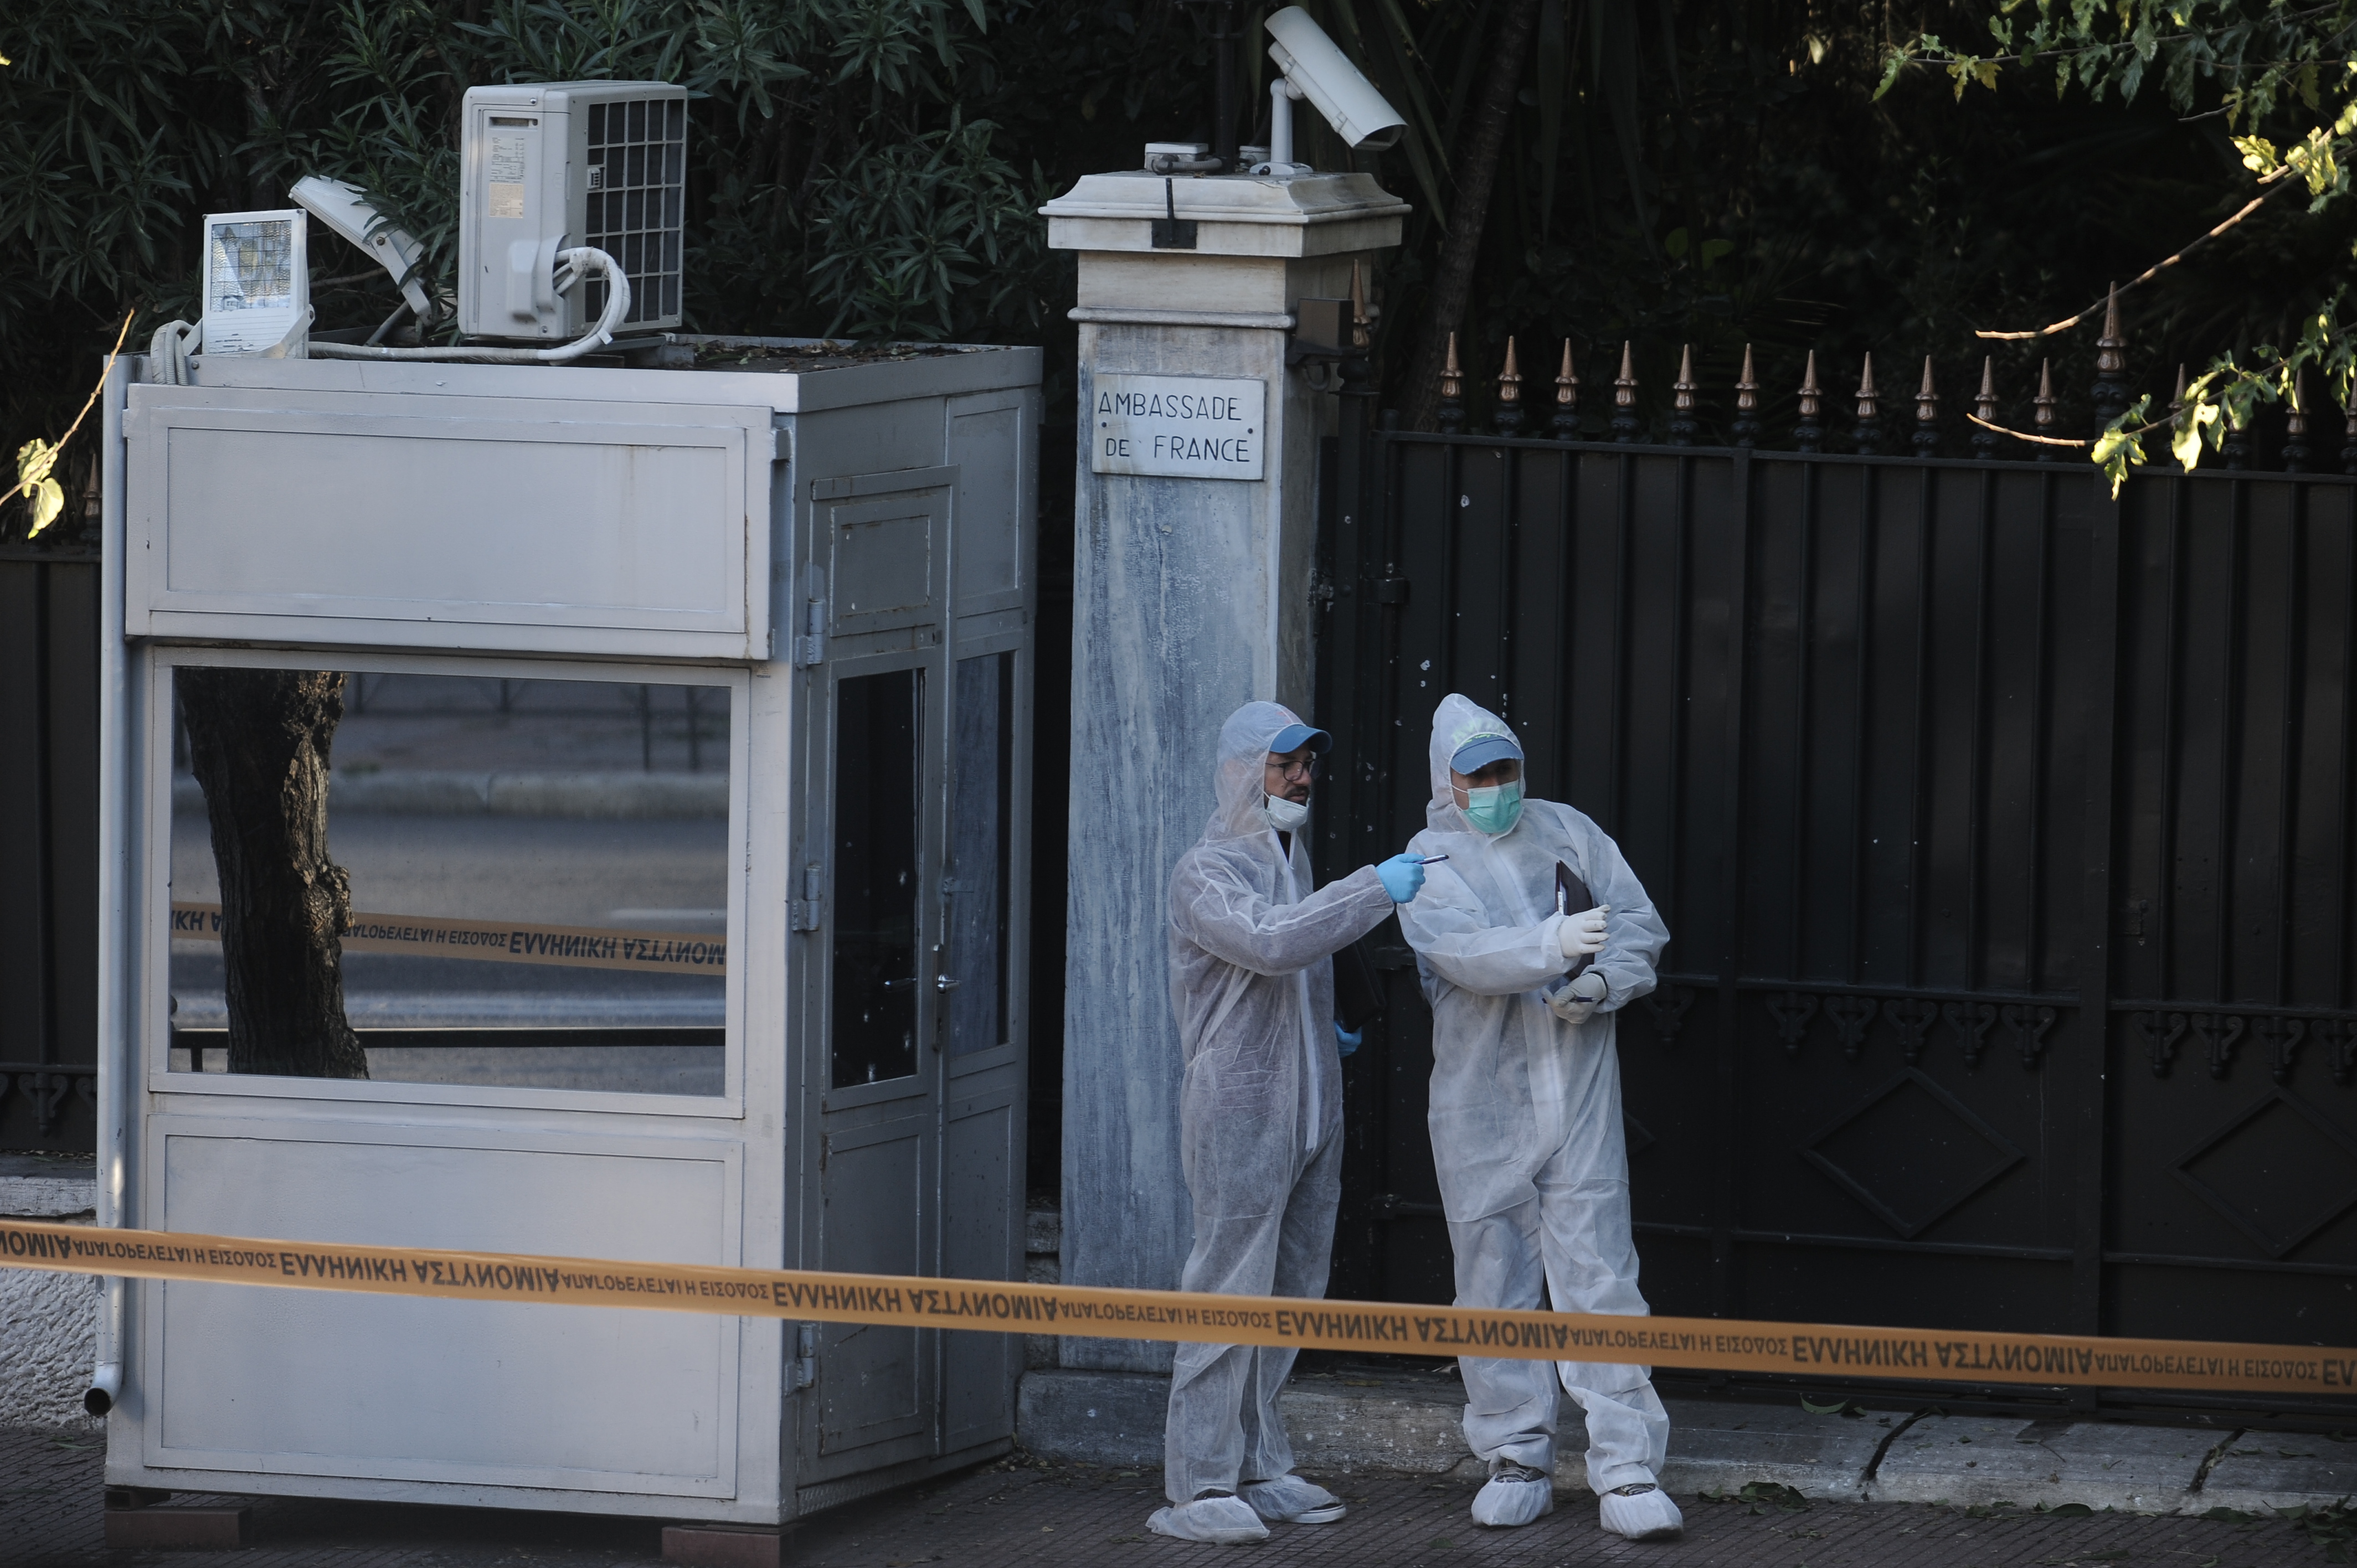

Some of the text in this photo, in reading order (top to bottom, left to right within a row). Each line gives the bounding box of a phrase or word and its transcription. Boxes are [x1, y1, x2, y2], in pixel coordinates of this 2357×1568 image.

[1098, 391, 1242, 421] AMBASSADE
[1106, 435, 1250, 462] DE FRANCE
